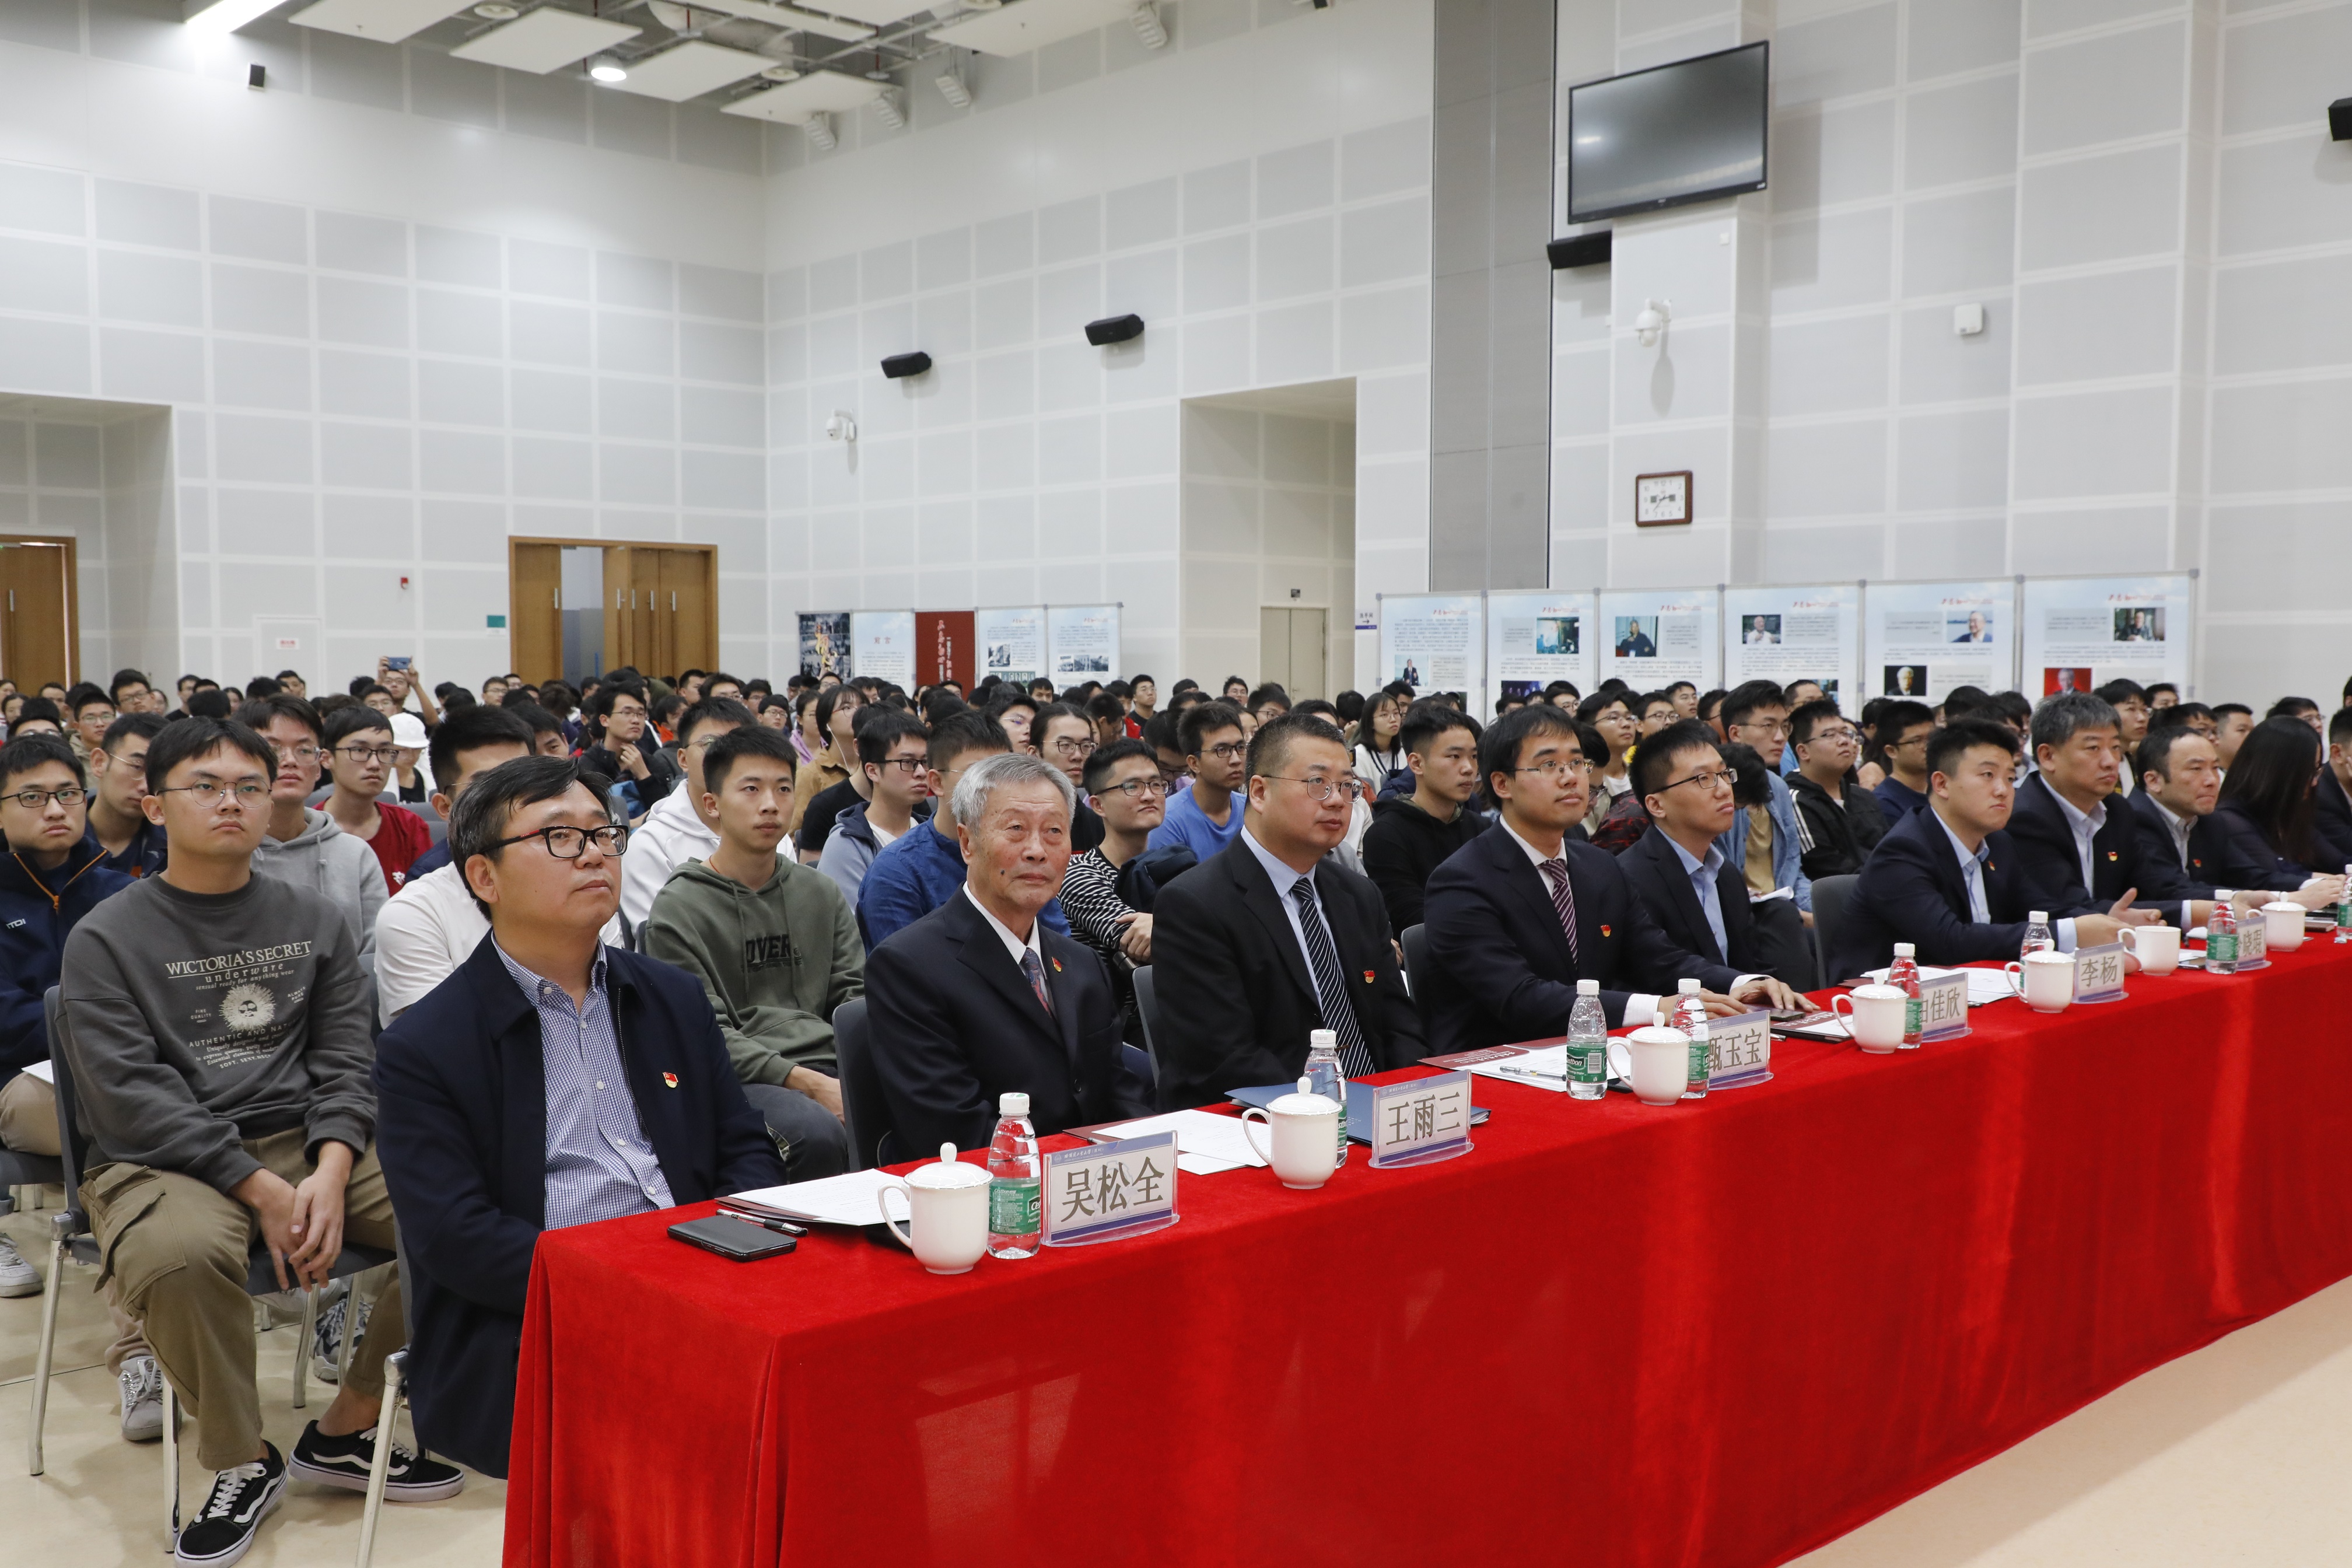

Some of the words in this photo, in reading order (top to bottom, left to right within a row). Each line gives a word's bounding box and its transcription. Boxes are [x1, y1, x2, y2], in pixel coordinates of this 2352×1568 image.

[165, 950, 254, 975] WICTORIA'S
[257, 940, 312, 963] SECRET
[205, 963, 284, 983] underware
[2081, 955, 2118, 988] 李杨
[196, 982, 217, 991] sensual
[237, 977, 247, 985] for
[250, 971, 279, 982] anything
[189, 1032, 243, 1048] AUTHENTIC
[247, 1028, 266, 1037] AND
[1386, 1091, 1461, 1146] 王雨三
[1060, 1156, 1166, 1223] 吴松全
